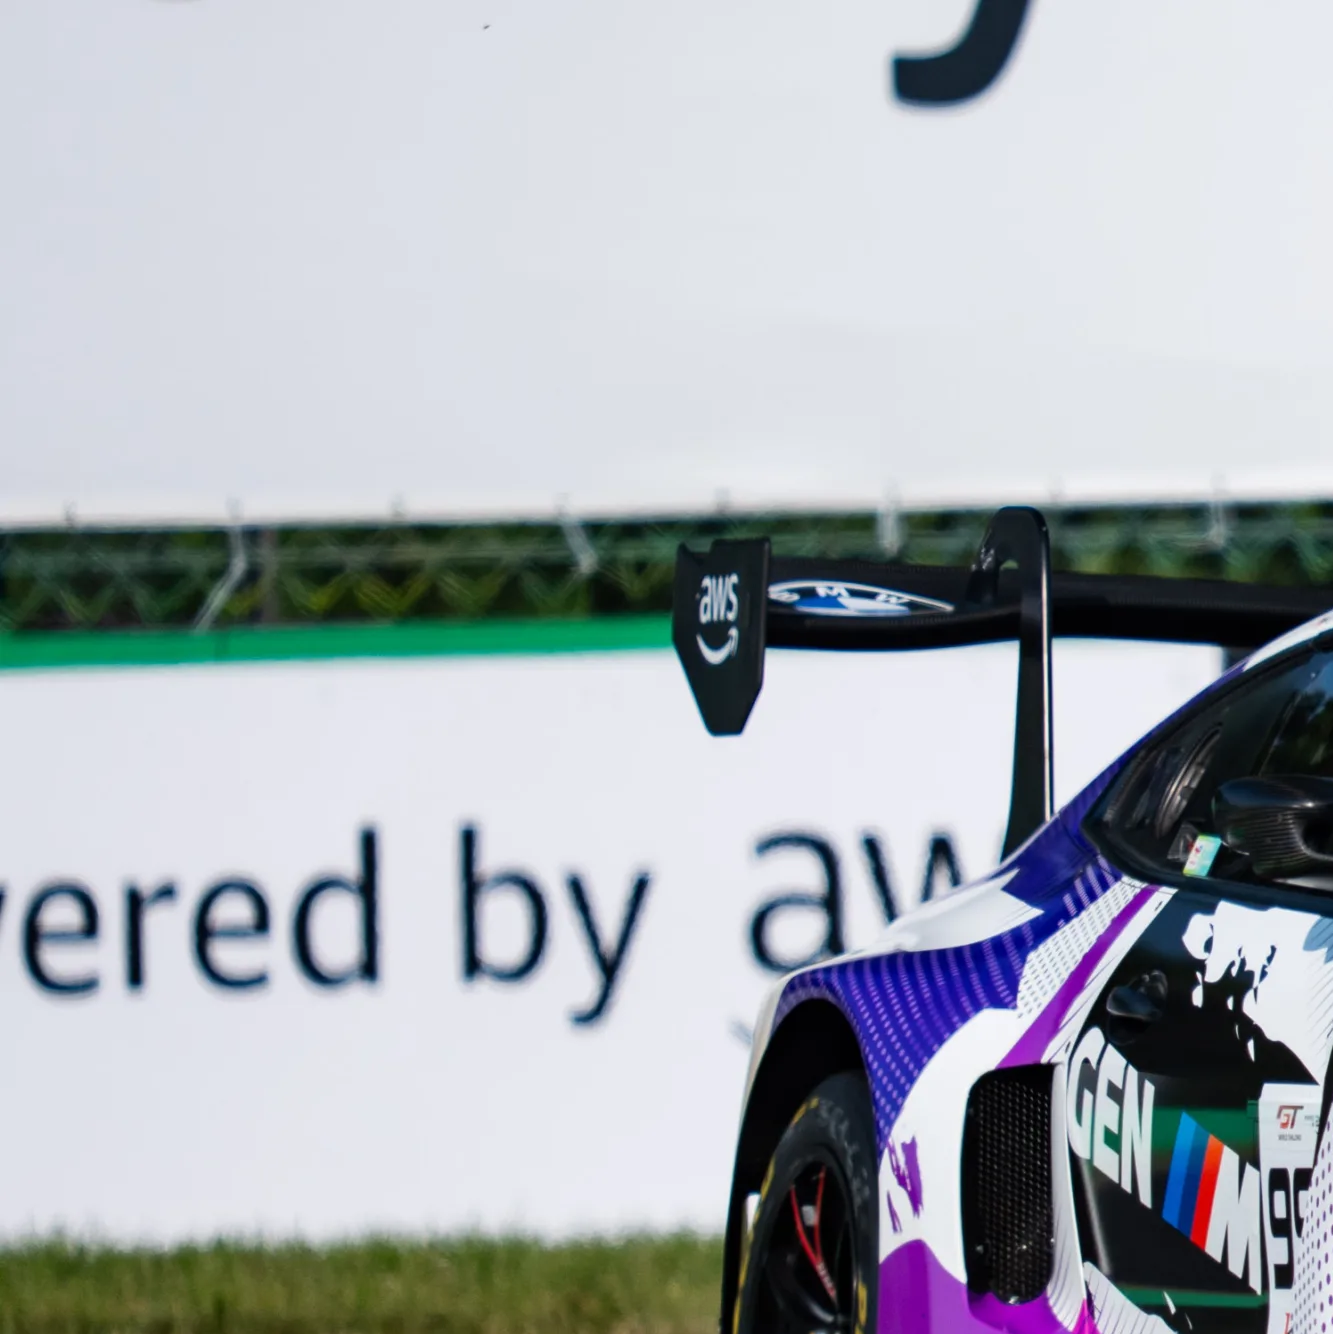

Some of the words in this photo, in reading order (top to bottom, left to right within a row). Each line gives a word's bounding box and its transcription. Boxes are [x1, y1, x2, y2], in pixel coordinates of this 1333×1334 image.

[698, 573, 739, 625] aws
[0, 822, 382, 998] ered
[455, 822, 655, 1027] by
[748, 828, 965, 976] aw
[1066, 1026, 1156, 1210] GEN
